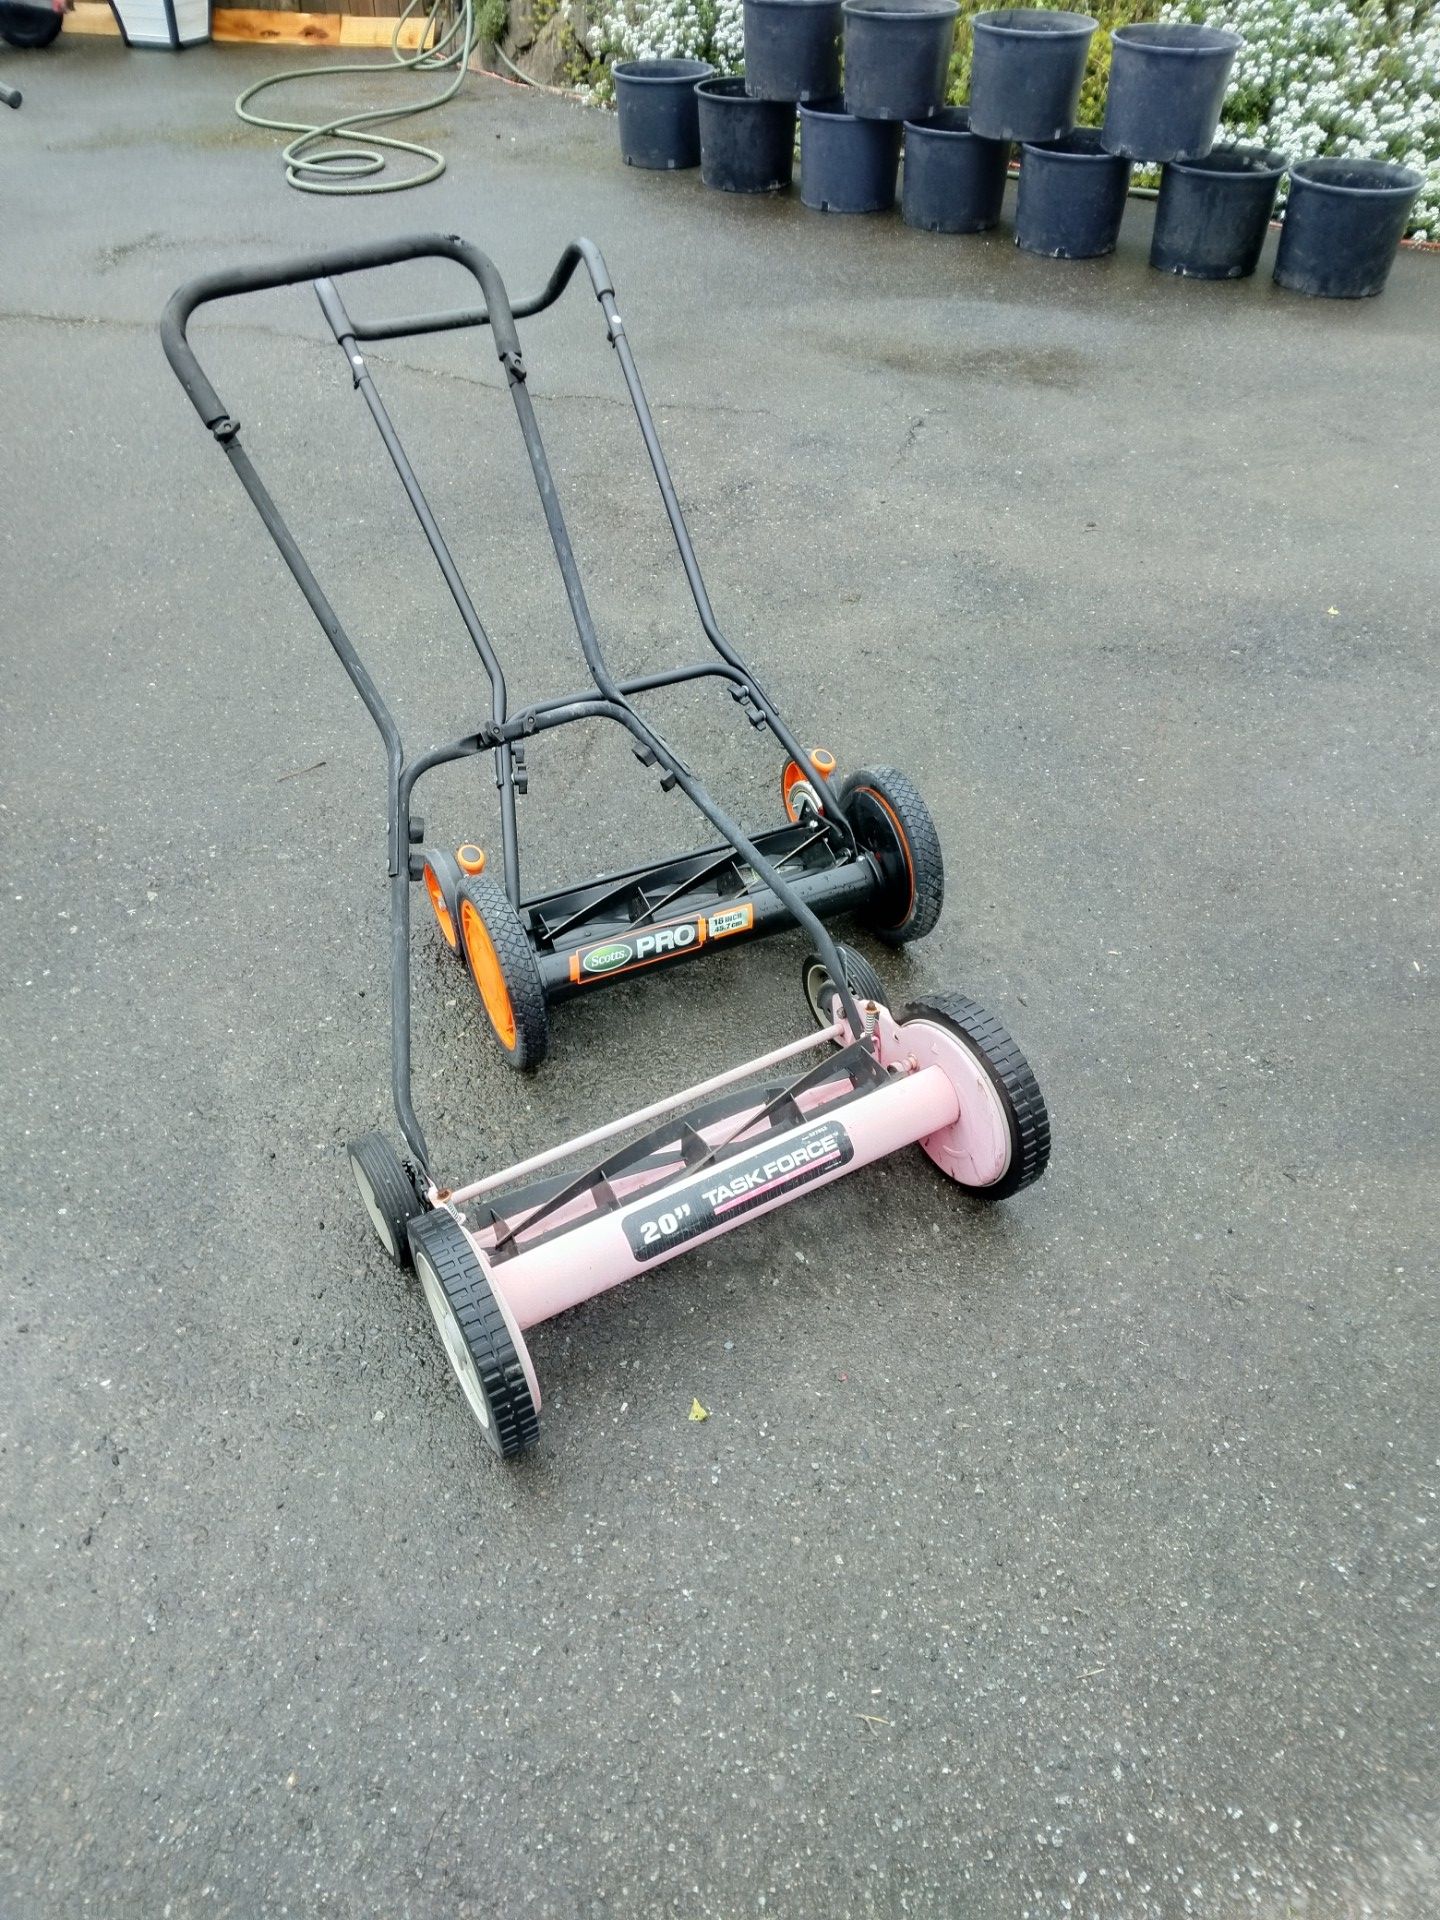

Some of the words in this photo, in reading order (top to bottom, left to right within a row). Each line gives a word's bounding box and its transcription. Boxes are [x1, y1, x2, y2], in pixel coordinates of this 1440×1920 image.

[591, 948, 627, 968] Scotts
[637, 925, 695, 959] PRO
[702, 1171, 768, 1206] TASK
[766, 1133, 839, 1180] FORCE
